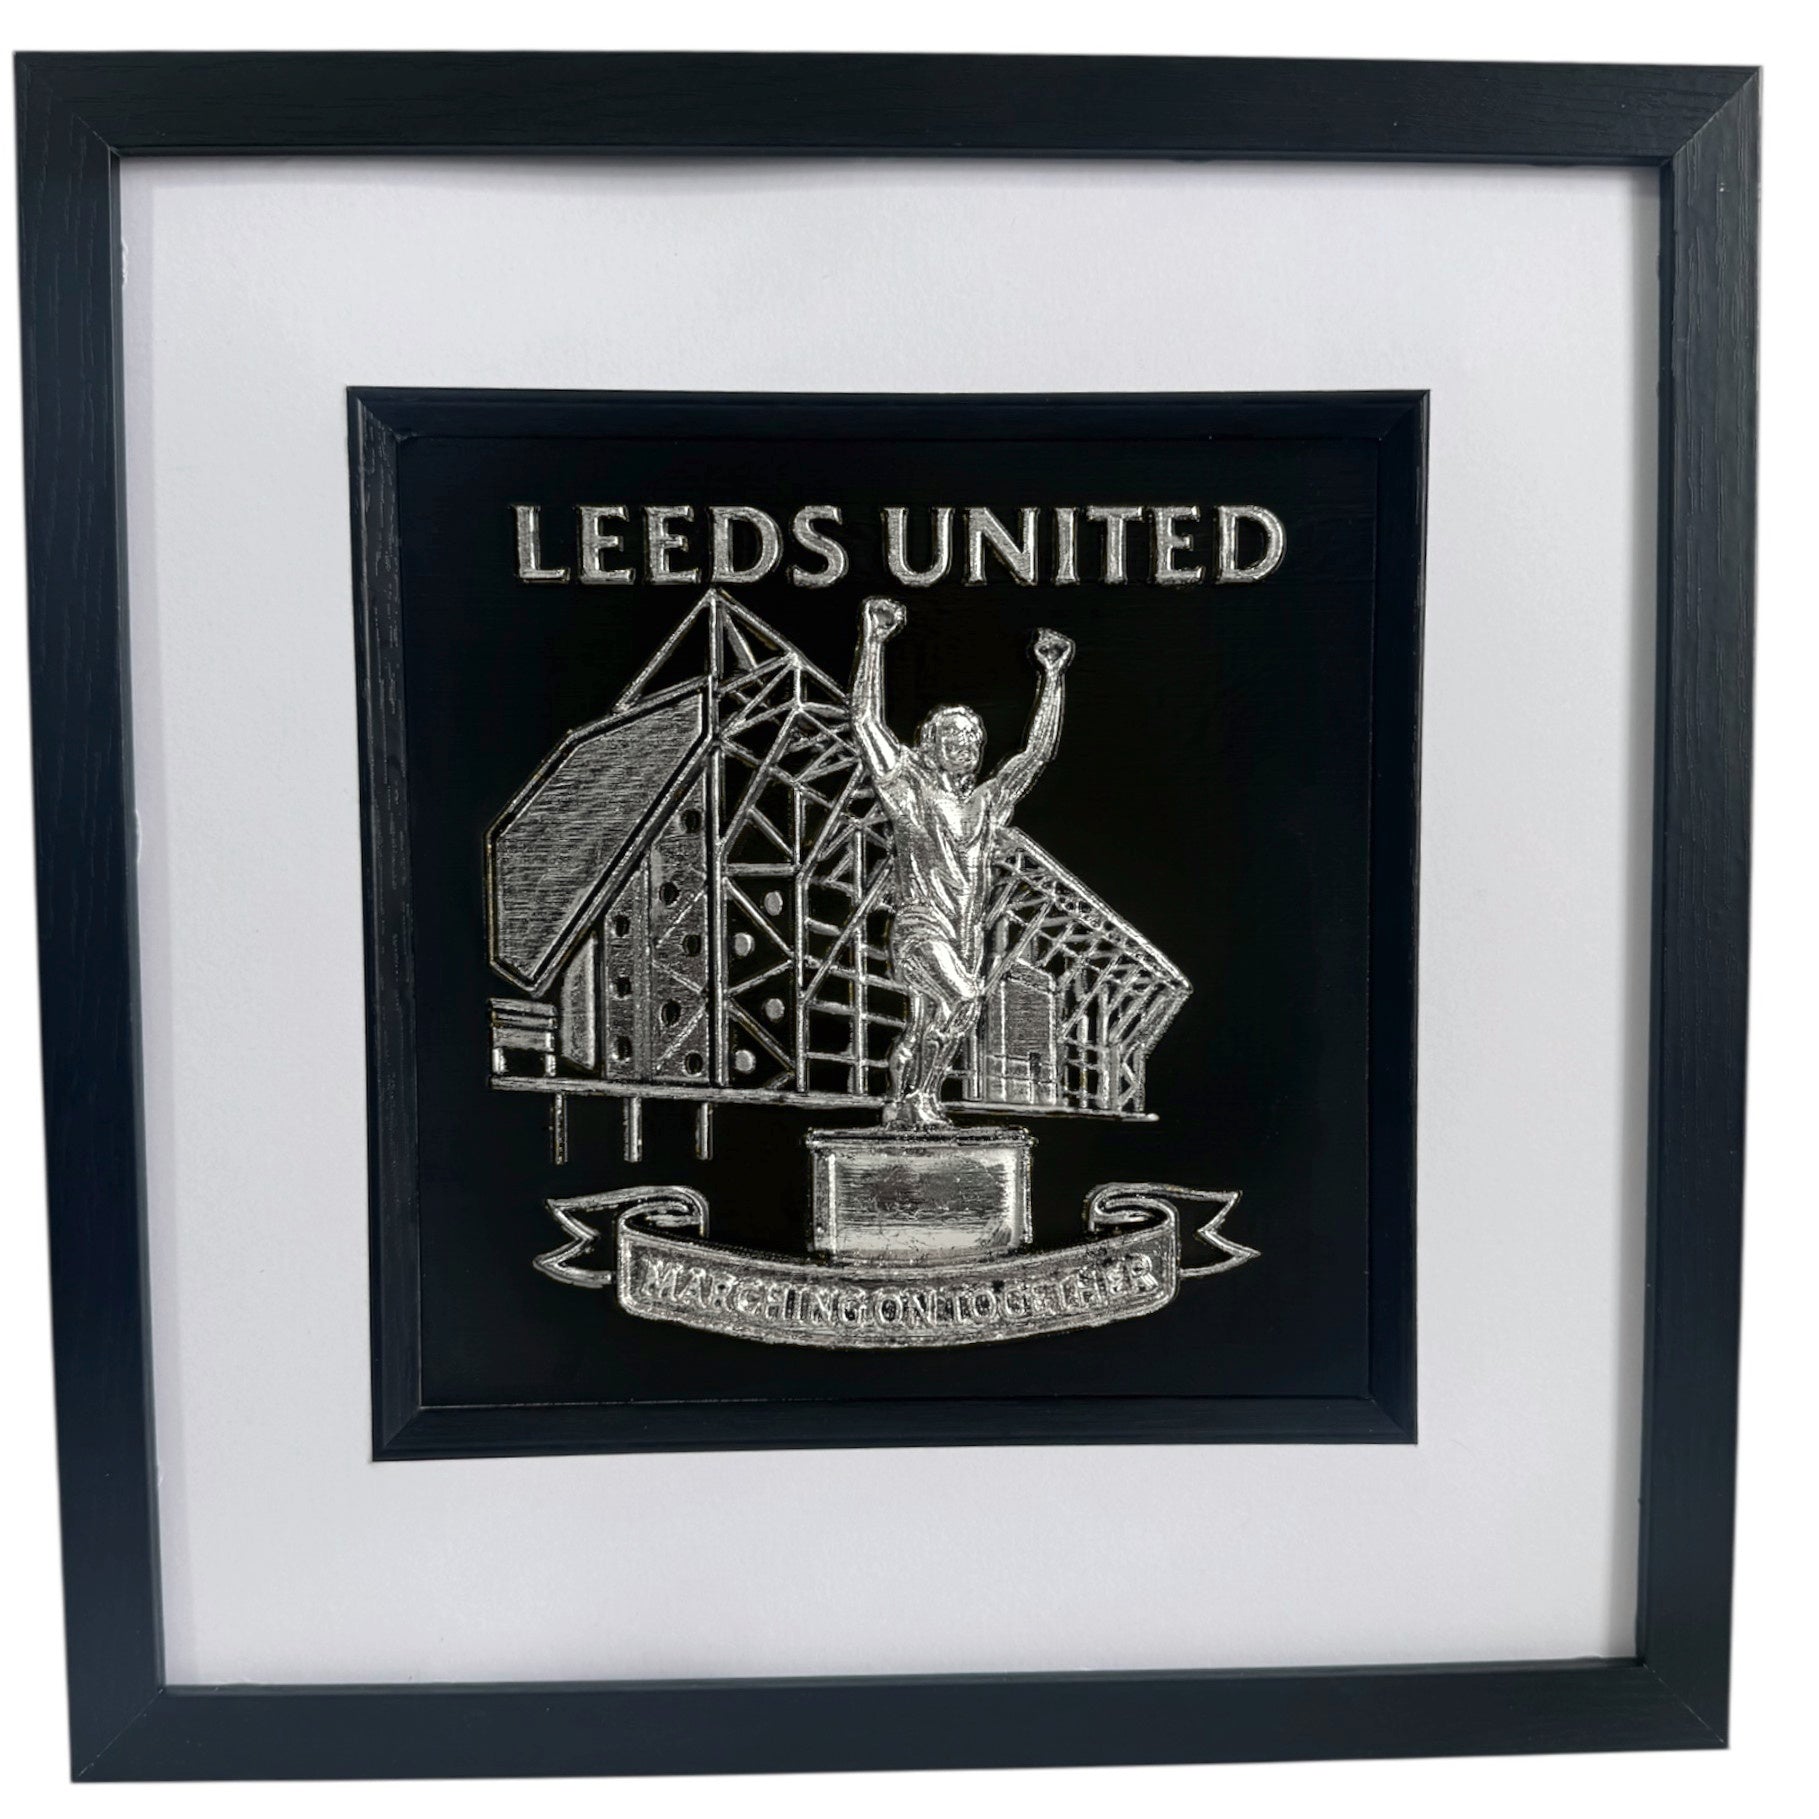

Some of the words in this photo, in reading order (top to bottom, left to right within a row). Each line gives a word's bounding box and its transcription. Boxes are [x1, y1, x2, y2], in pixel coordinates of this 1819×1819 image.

[511, 504, 850, 587] LEEDS
[882, 504, 1288, 586] UNITED
[640, 1258, 868, 1327] MARCHING
[874, 1282, 941, 1329] ON
[943, 1252, 1160, 1325] TOGETHER
